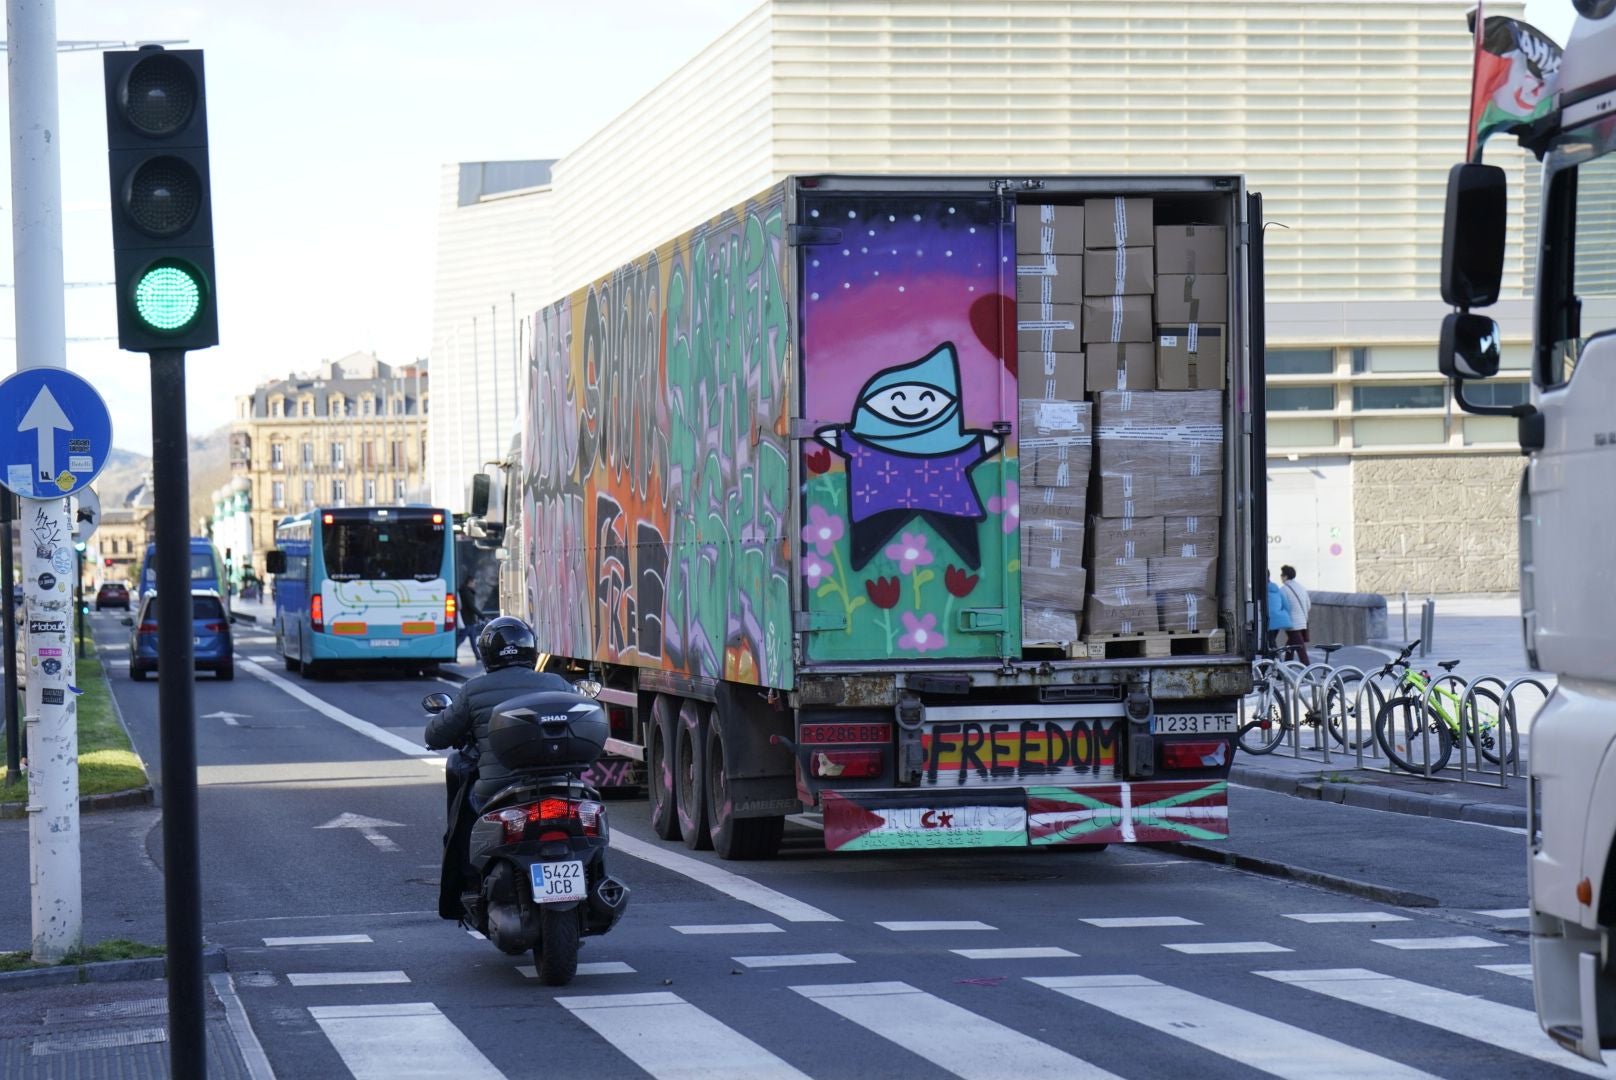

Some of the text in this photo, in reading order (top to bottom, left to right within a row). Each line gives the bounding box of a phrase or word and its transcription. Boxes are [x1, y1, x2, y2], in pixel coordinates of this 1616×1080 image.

[541, 714, 568, 722] SHAD
[1158, 715, 1233, 731] 1233 FTF
[816, 727, 856, 741] 6286
[928, 719, 1122, 784] FREEDOM
[735, 799, 798, 811] LAMBERET
[543, 864, 580, 879] 5422
[546, 879, 573, 895] JCB
